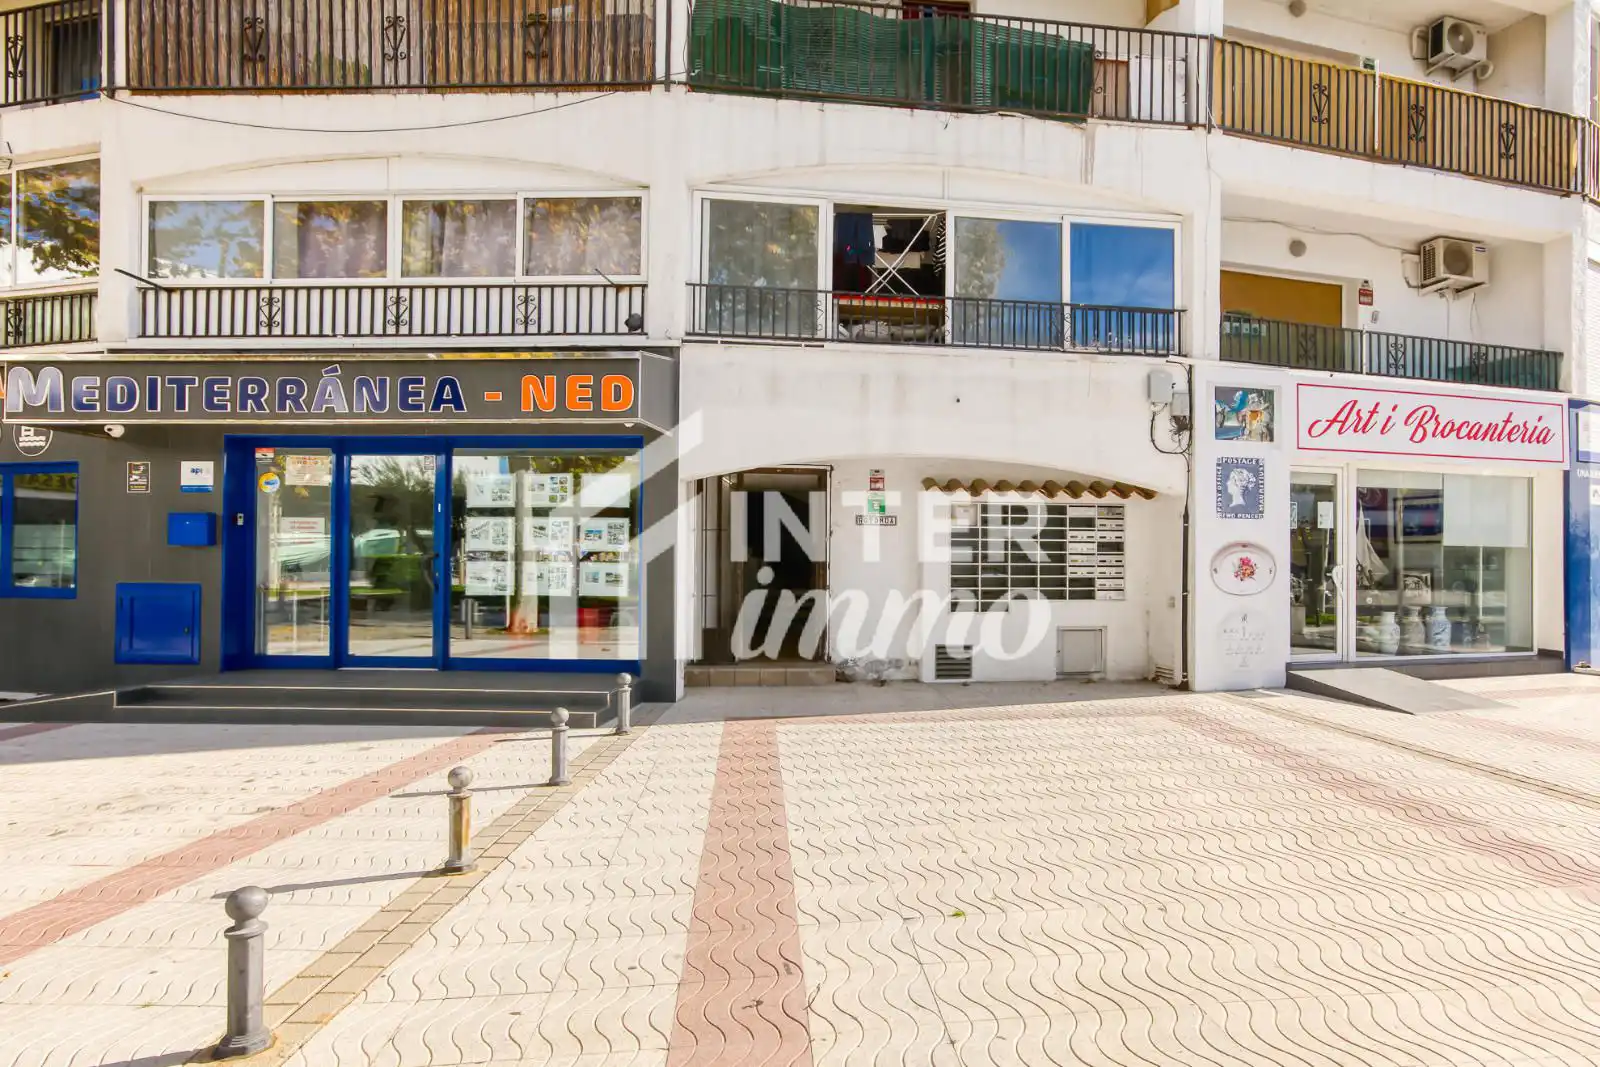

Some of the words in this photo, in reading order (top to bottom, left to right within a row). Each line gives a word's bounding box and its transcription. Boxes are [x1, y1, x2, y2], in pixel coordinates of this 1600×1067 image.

[6, 364, 468, 413] MEDITERRÁNEA
[520, 374, 634, 412] NED
[1307, 399, 1379, 439] Art
[1380, 403, 1398, 435] i
[1403, 404, 1556, 444] Brocanteria
[1222, 457, 1258, 465] POSTAGE
